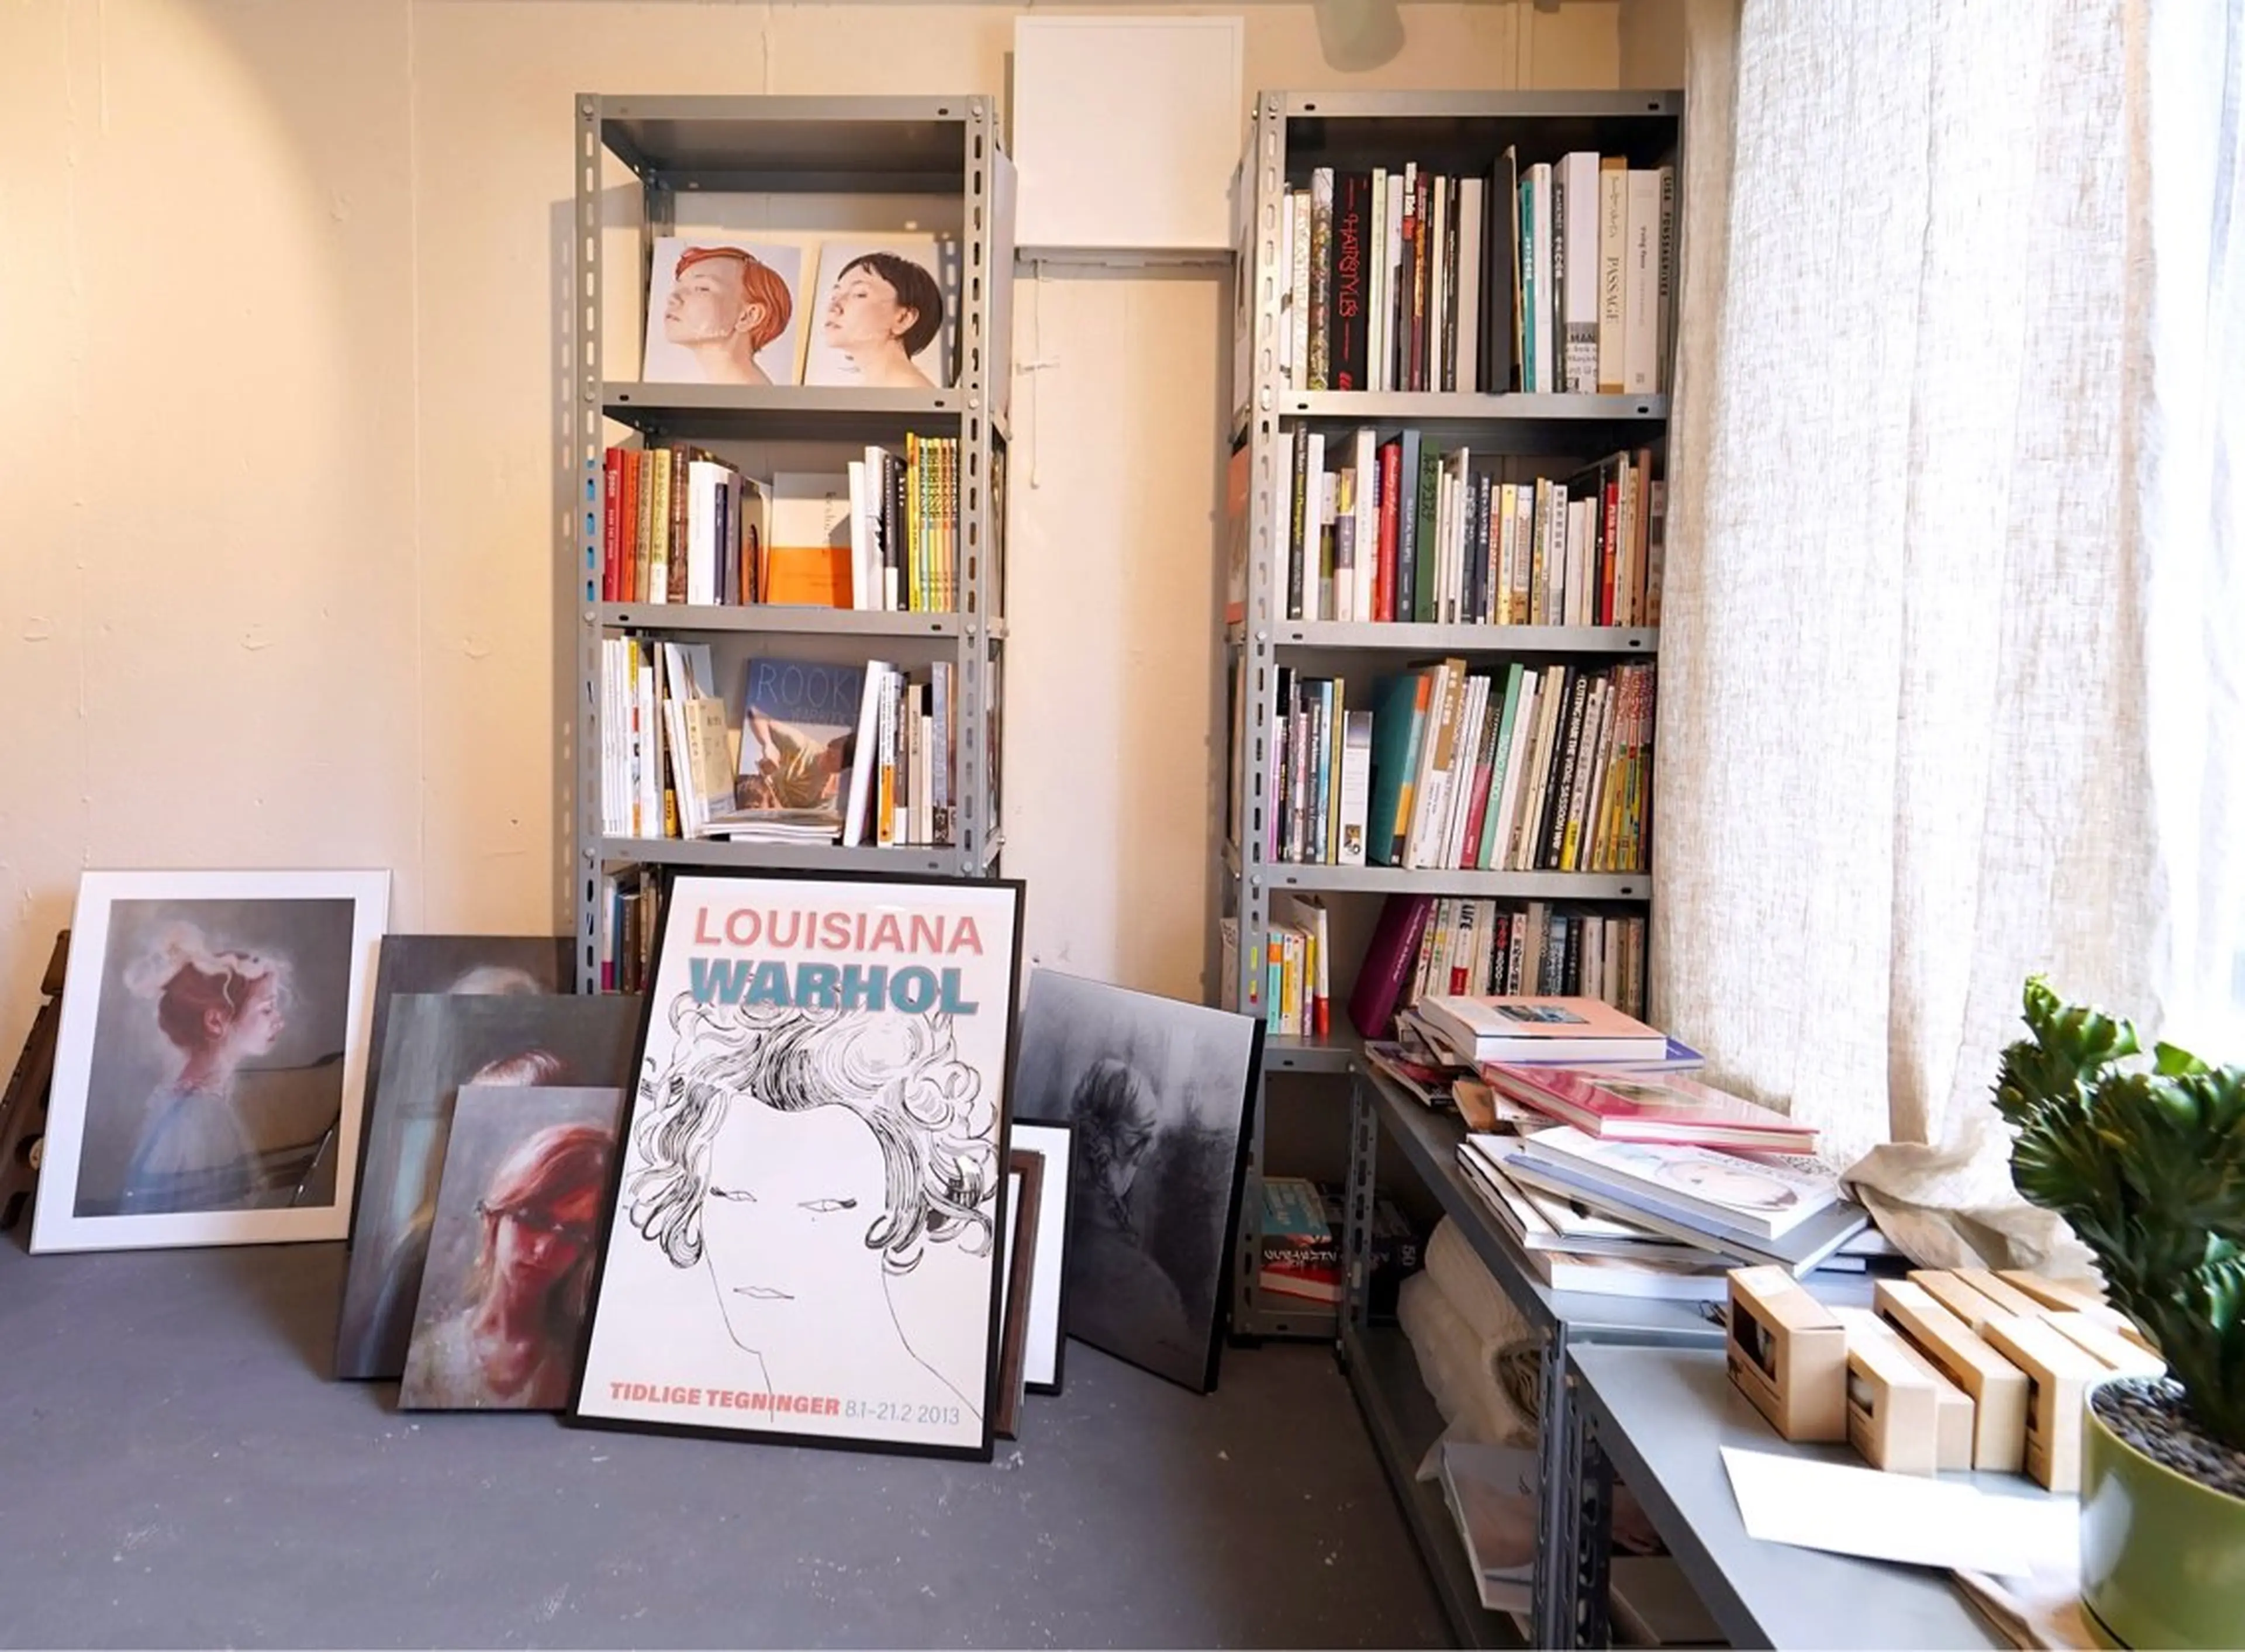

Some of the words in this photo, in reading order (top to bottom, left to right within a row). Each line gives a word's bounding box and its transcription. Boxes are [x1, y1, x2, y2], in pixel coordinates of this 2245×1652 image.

[1662, 176, 1672, 202] LISA
[1339, 213, 1360, 317] HAIRSTYLES
[1605, 256, 1619, 324] PASSAGE
[757, 663, 861, 709] ROOKI
[1571, 679, 1587, 716] CUTTING
[1567, 739, 1577, 755] THE
[1561, 756, 1574, 784] VIDAL
[1555, 785, 1569, 829] SASSOON
[694, 907, 983, 955] LOUISIANA
[1459, 904, 1475, 932] LIFE
[689, 957, 979, 1014] WARHOL
[610, 1382, 702, 1405] TIDLIGE
[706, 1388, 841, 1416] TEGNINGER
[917, 1405, 960, 1425] 2013
